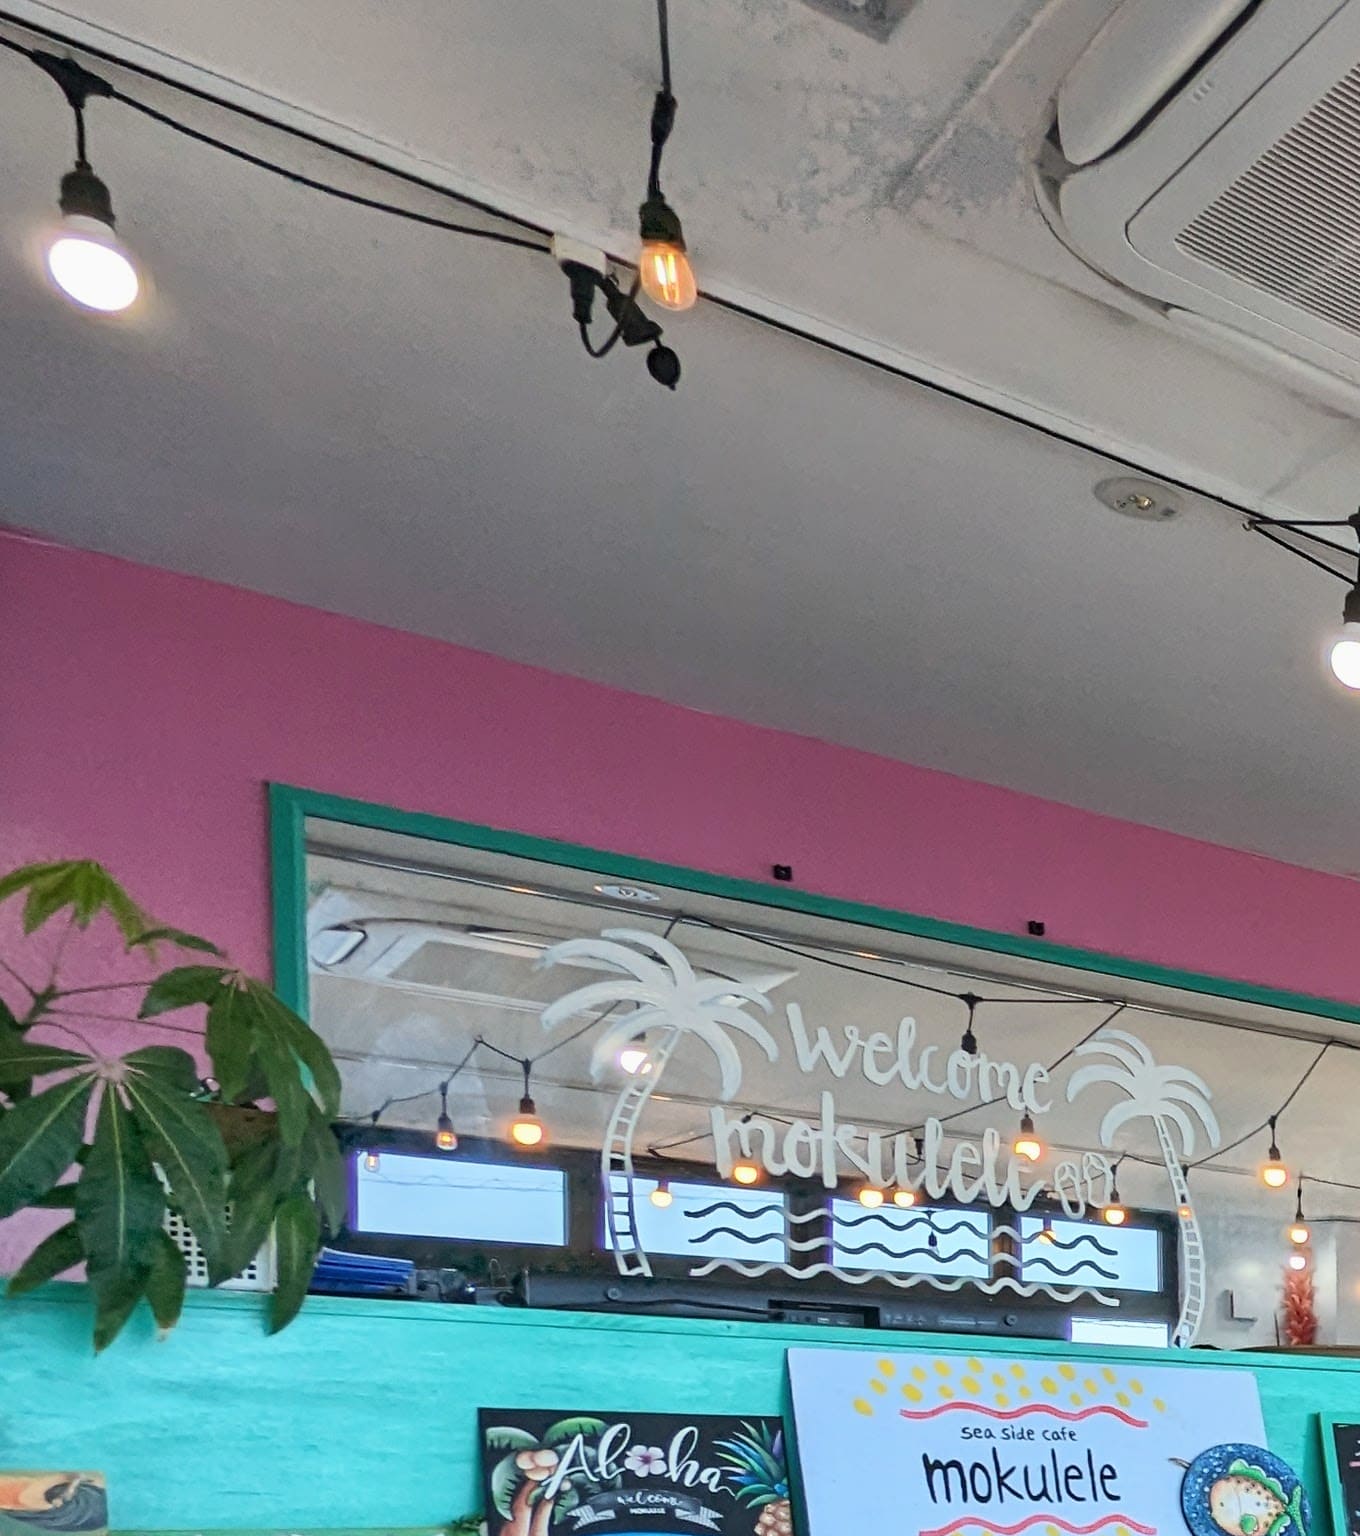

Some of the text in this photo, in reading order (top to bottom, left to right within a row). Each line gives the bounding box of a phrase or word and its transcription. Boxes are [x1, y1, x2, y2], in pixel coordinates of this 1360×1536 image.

[960, 1424, 1078, 1442] sea side cafe
[922, 1447, 1122, 1504] mokulele
